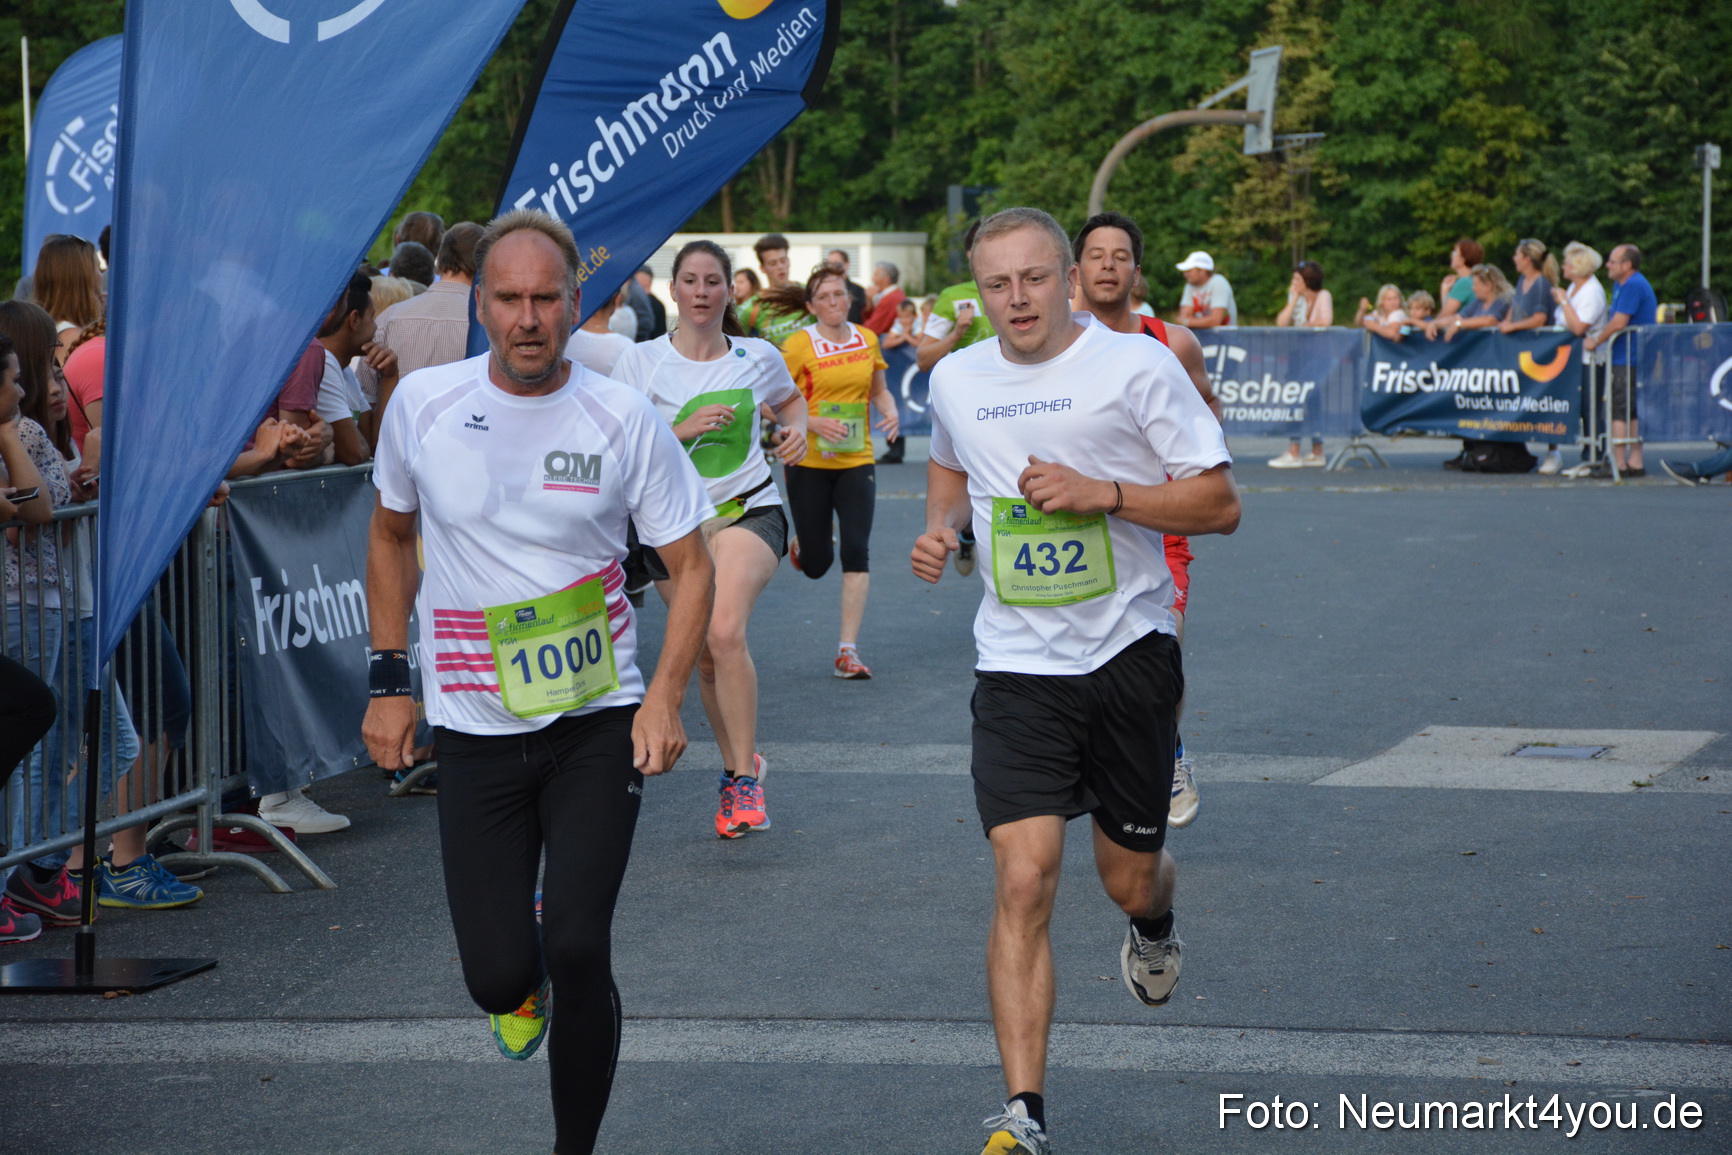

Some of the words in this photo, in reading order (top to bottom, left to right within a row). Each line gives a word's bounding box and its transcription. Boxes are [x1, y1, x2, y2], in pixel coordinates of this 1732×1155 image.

[662, 100, 716, 159] Druck
[714, 69, 750, 109] und
[750, 7, 818, 83] Medien
[68, 103, 117, 193] Fisc
[818, 358, 844, 370] MAX
[1206, 371, 1316, 404] ischer
[1371, 360, 1521, 394] Frischmann
[977, 398, 1072, 421] CHRISTOPHER
[1222, 407, 1305, 422] TOMOBILE
[1454, 393, 1494, 410] Druck
[1495, 396, 1521, 412] und
[1519, 396, 1570, 413] Medien
[464, 421, 489, 431] erima
[544, 450, 602, 480] OM
[1006, 516, 1042, 526] firmenlauf
[1013, 539, 1088, 577] 432
[1011, 584, 1052, 592] Christopher
[1053, 577, 1098, 591] Puschmann
[250, 563, 421, 656] Frischm
[509, 613, 555, 632] firmenlauf
[510, 628, 602, 685] 1000
[1135, 826, 1158, 835] JAKO
